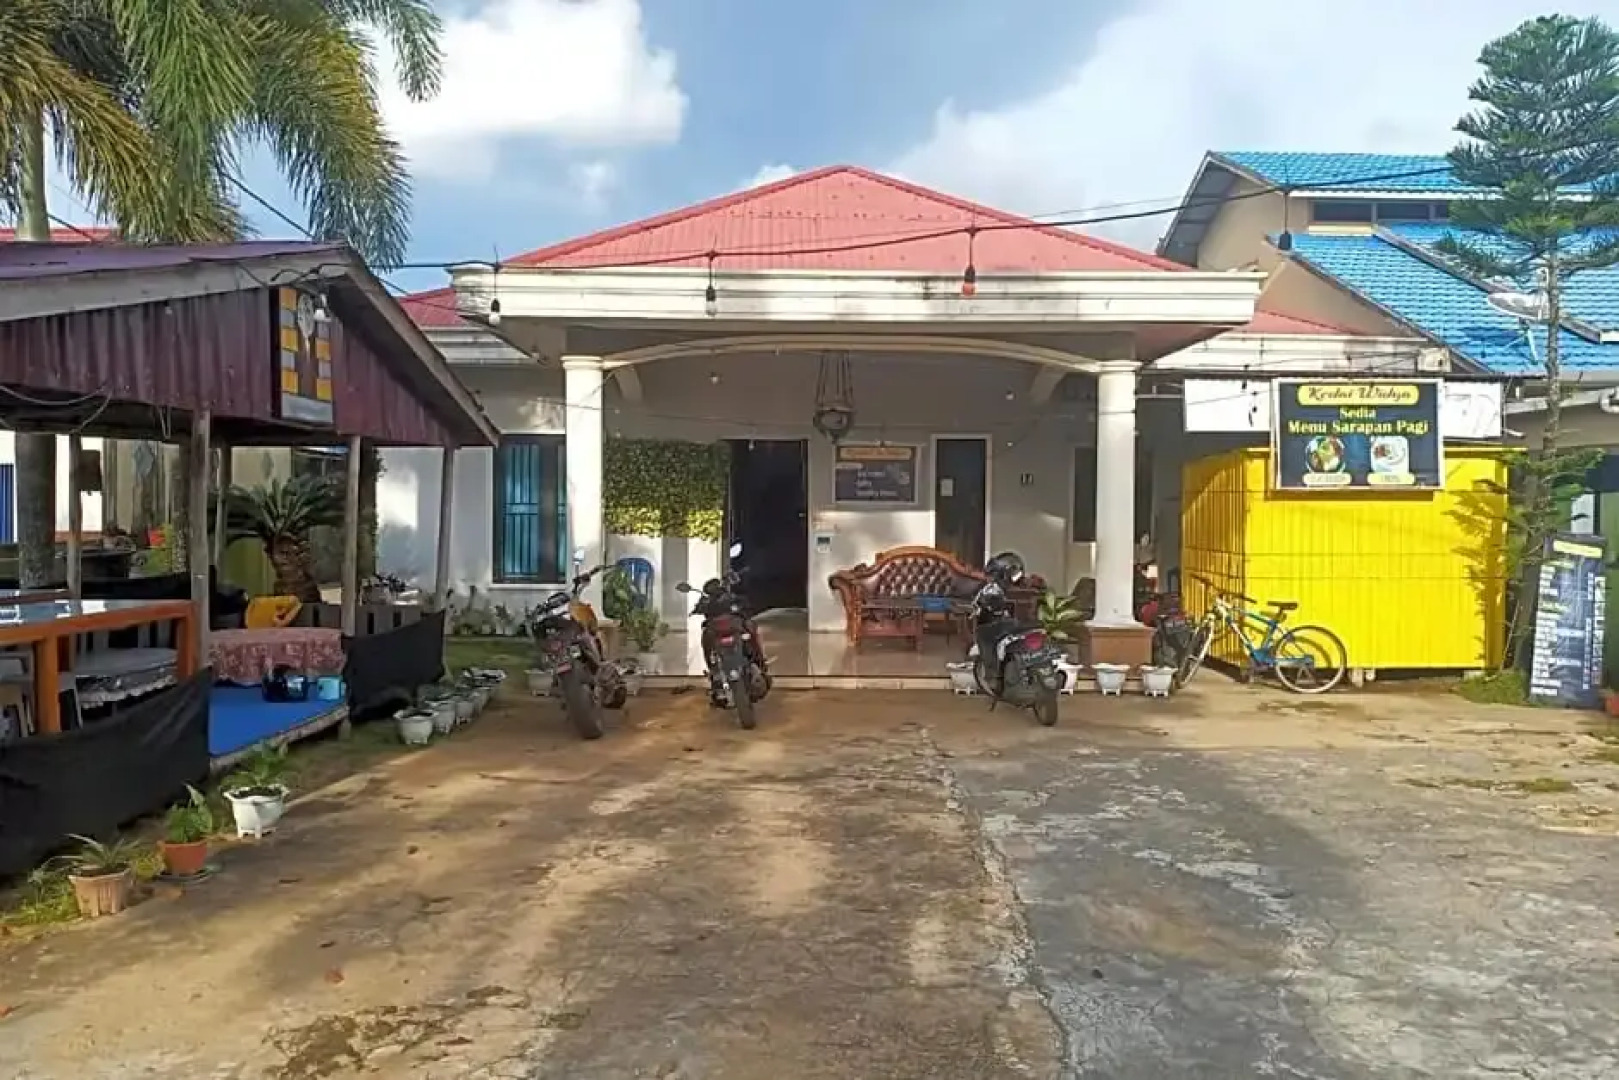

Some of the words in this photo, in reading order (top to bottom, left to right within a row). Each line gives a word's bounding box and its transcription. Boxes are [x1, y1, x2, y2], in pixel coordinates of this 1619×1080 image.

[1340, 406, 1376, 418] Sedia
[1288, 421, 1327, 433] Menu
[1333, 419, 1392, 435] Sarapan
[1397, 420, 1428, 435] Pagi
